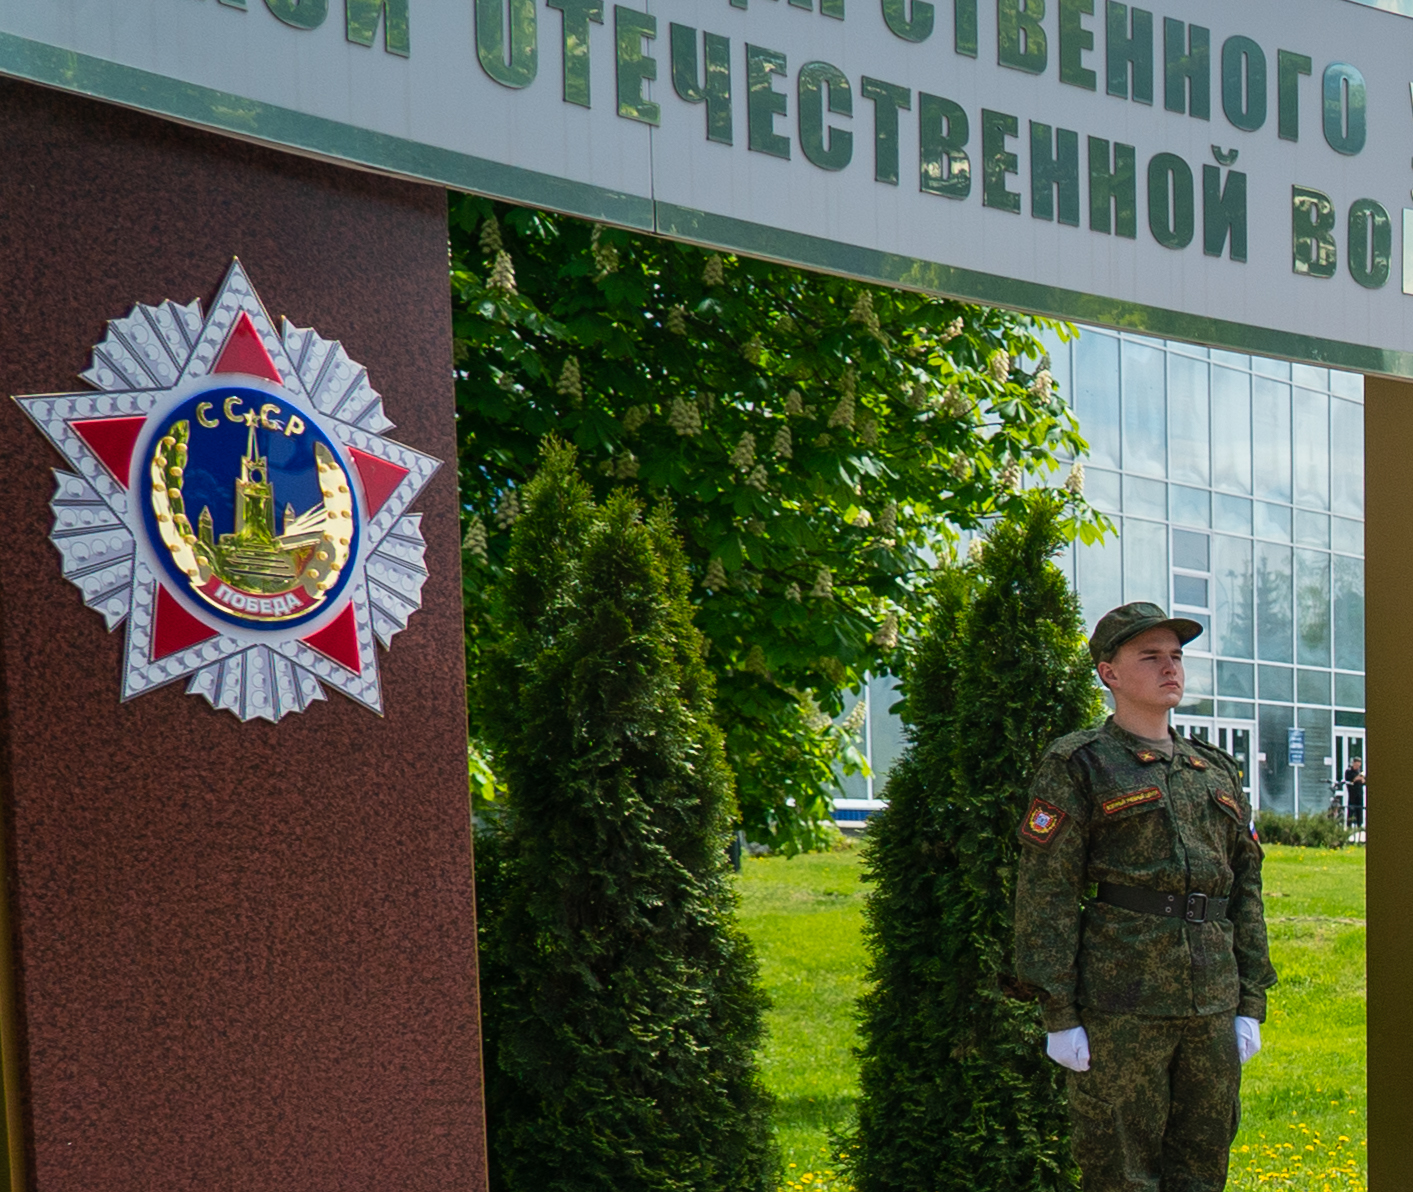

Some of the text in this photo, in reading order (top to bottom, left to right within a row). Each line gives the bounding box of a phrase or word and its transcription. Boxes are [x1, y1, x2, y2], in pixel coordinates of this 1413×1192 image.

[475, 0, 1247, 263] ОТЕЧЕСТВЕННОЙ
[196, 396, 306, 437] СССР
[213, 581, 304, 617] ПОБЕДА
